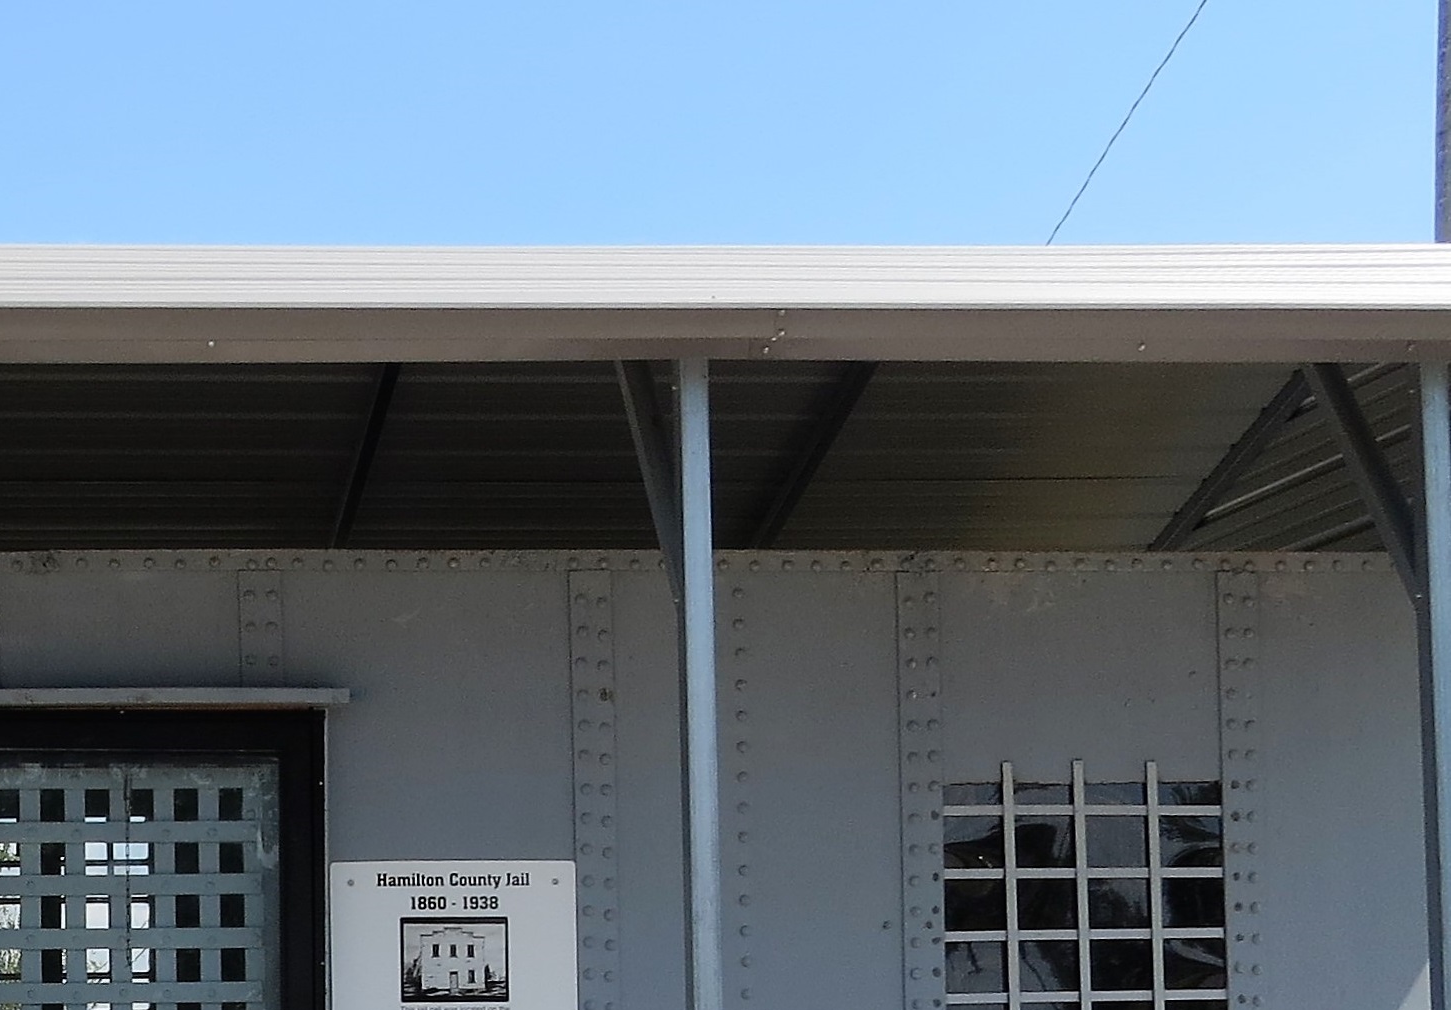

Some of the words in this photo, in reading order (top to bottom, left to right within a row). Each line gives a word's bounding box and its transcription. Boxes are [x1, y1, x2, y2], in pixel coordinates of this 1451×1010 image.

[377, 873, 444, 886] Hamilton
[449, 873, 502, 889] County
[506, 873, 530, 886] Jail
[411, 896, 447, 910] 1860
[462, 896, 499, 910] 1938
